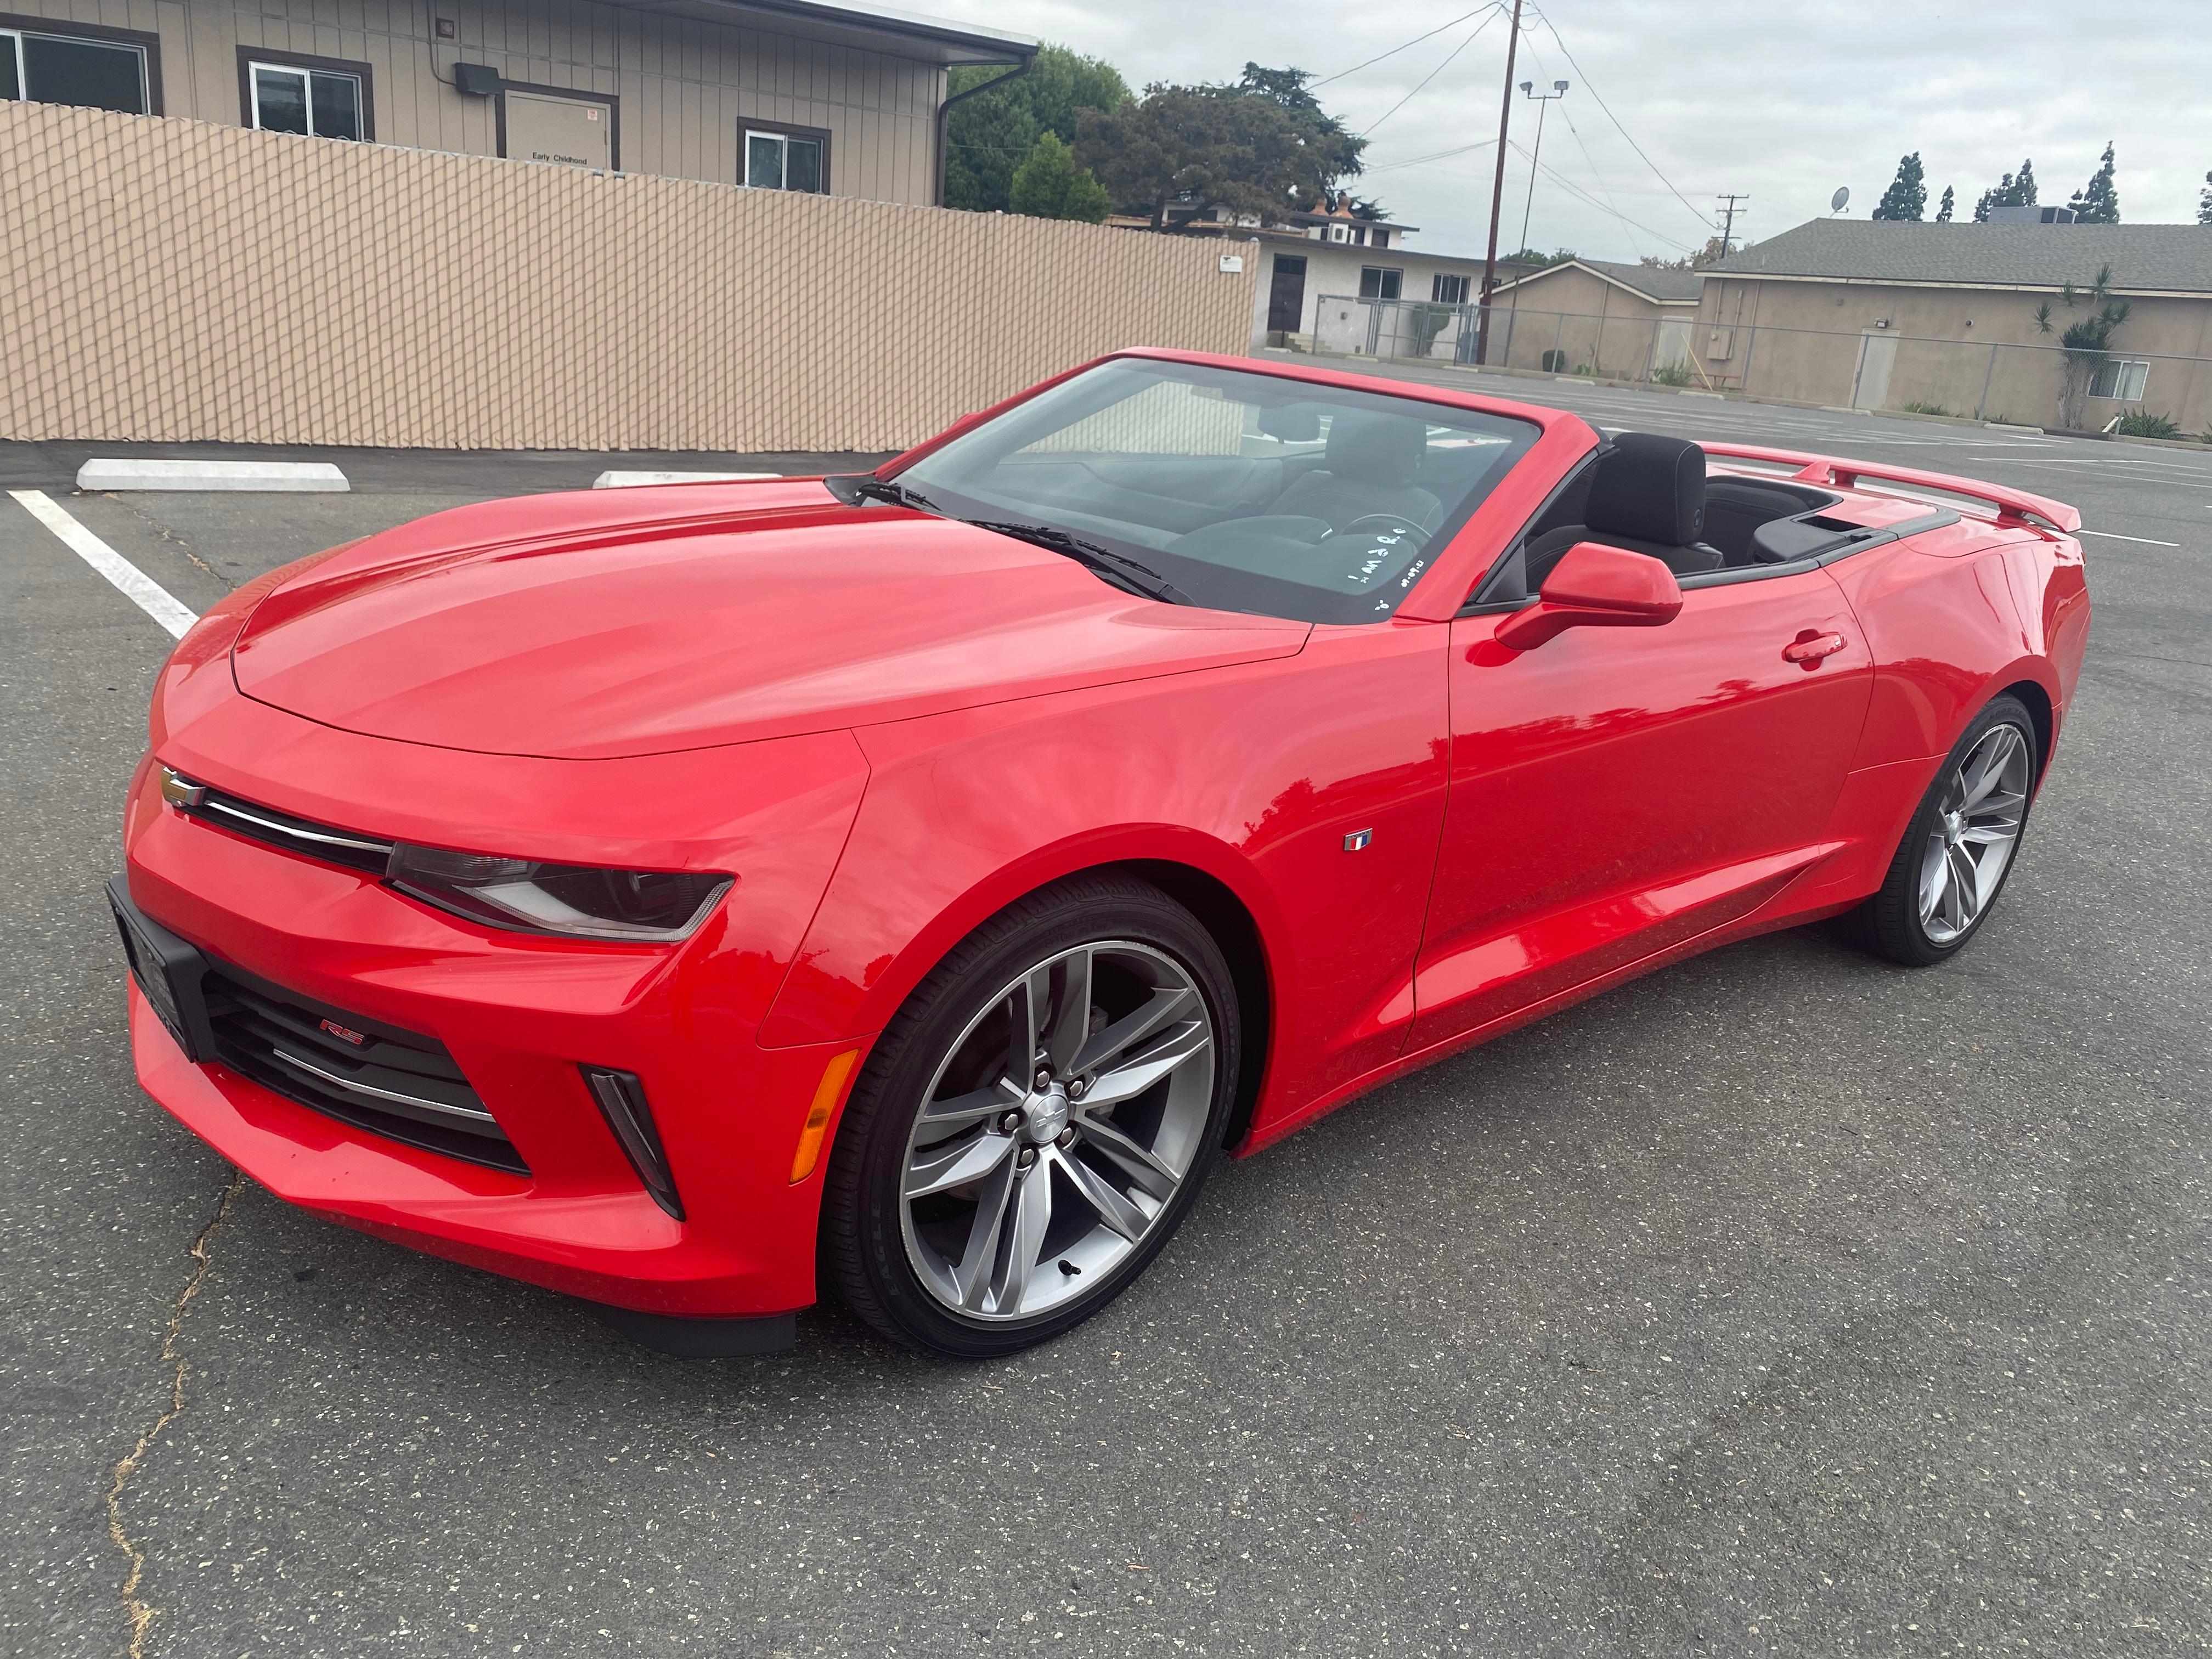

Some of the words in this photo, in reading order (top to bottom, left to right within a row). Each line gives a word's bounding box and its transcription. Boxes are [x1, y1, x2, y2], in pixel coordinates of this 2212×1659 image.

[532, 152, 550, 161] Early
[553, 154, 588, 165] Childhood
[319, 1019, 365, 1045] RS
[872, 1202, 900, 1296] EAGLE
